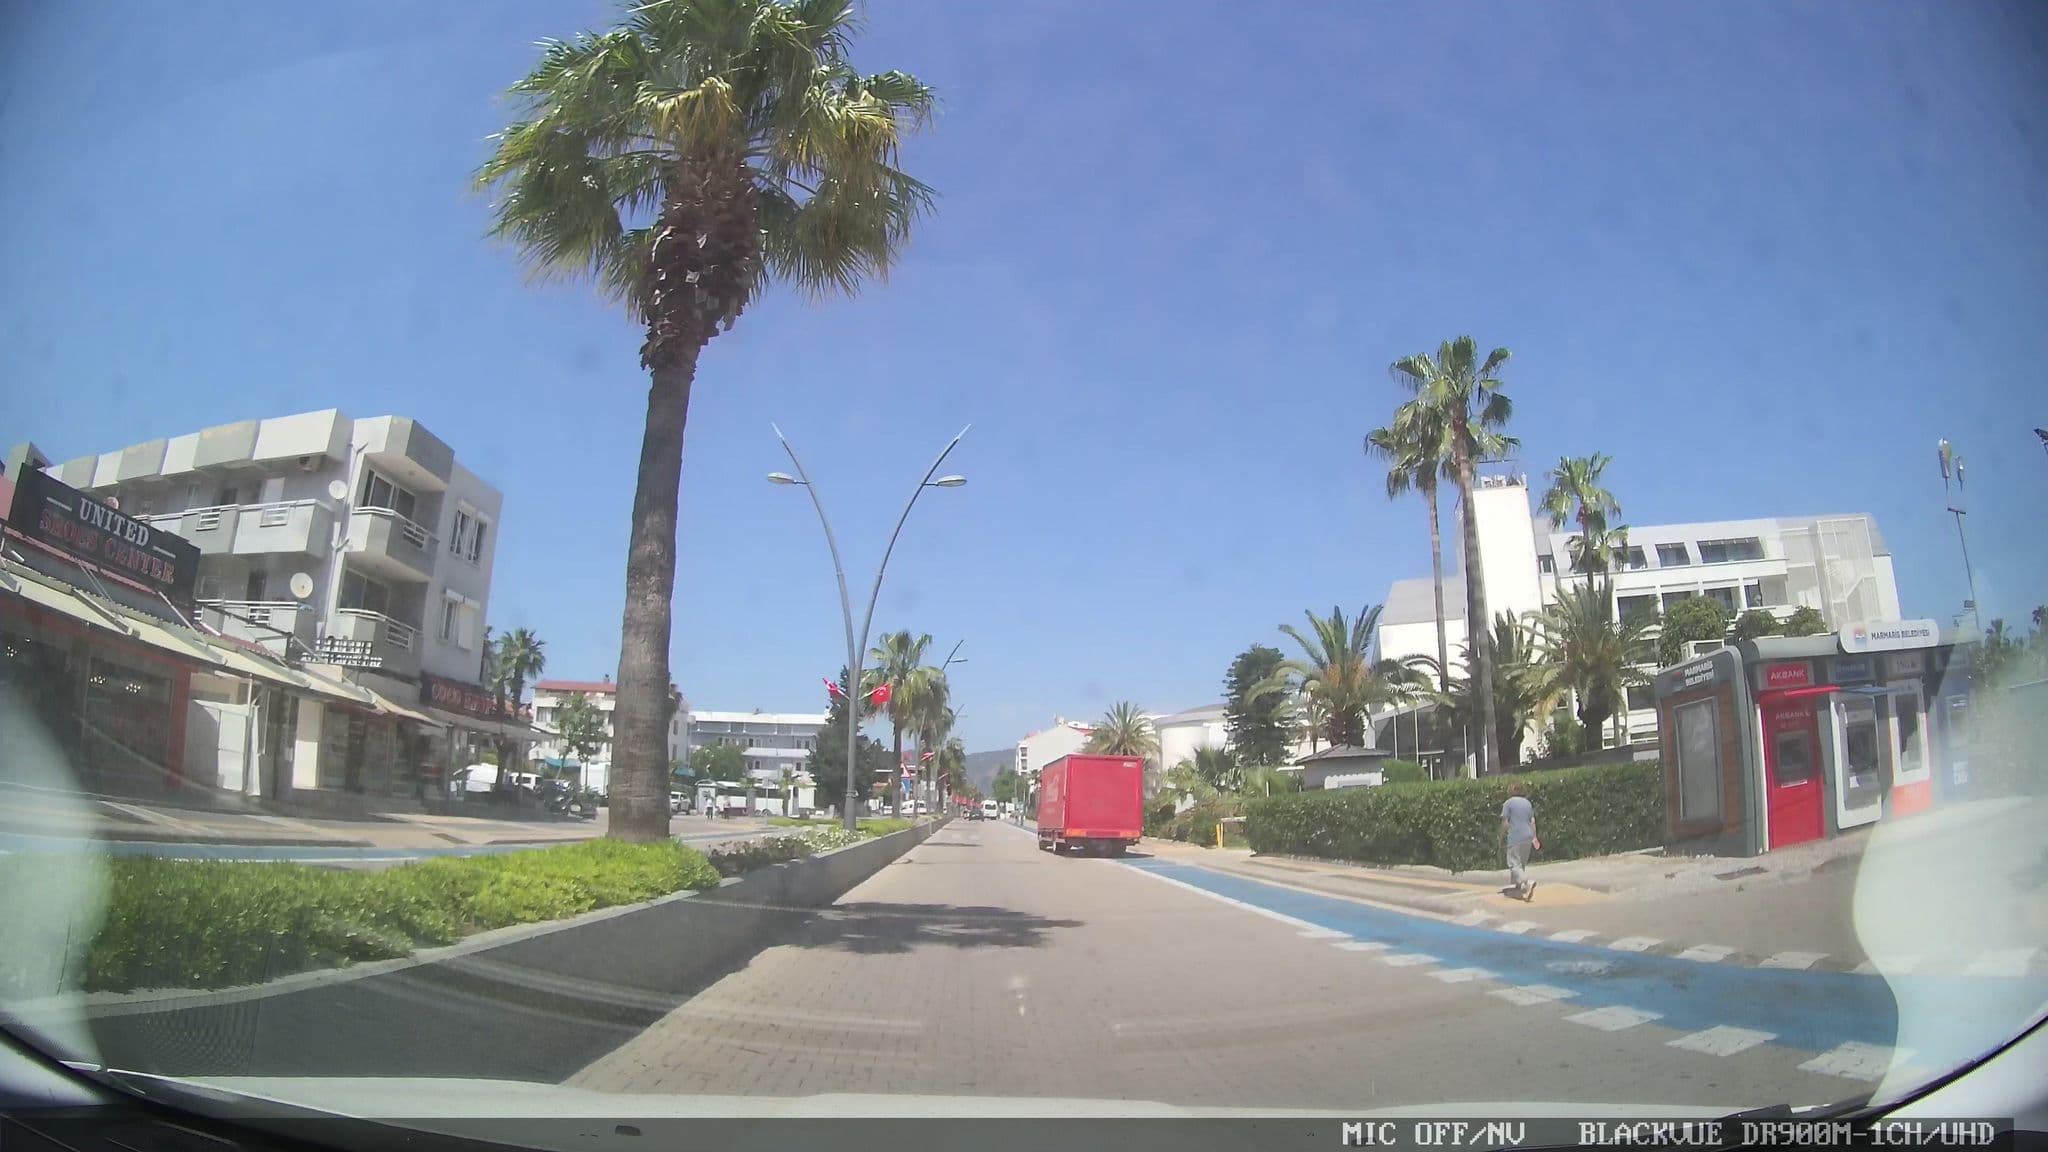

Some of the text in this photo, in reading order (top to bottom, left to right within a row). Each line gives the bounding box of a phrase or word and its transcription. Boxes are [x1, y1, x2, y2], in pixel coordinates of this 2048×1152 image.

[80, 498, 149, 547] UNITED
[104, 537, 174, 585] CENTER
[1770, 669, 1805, 680] AKBANK
